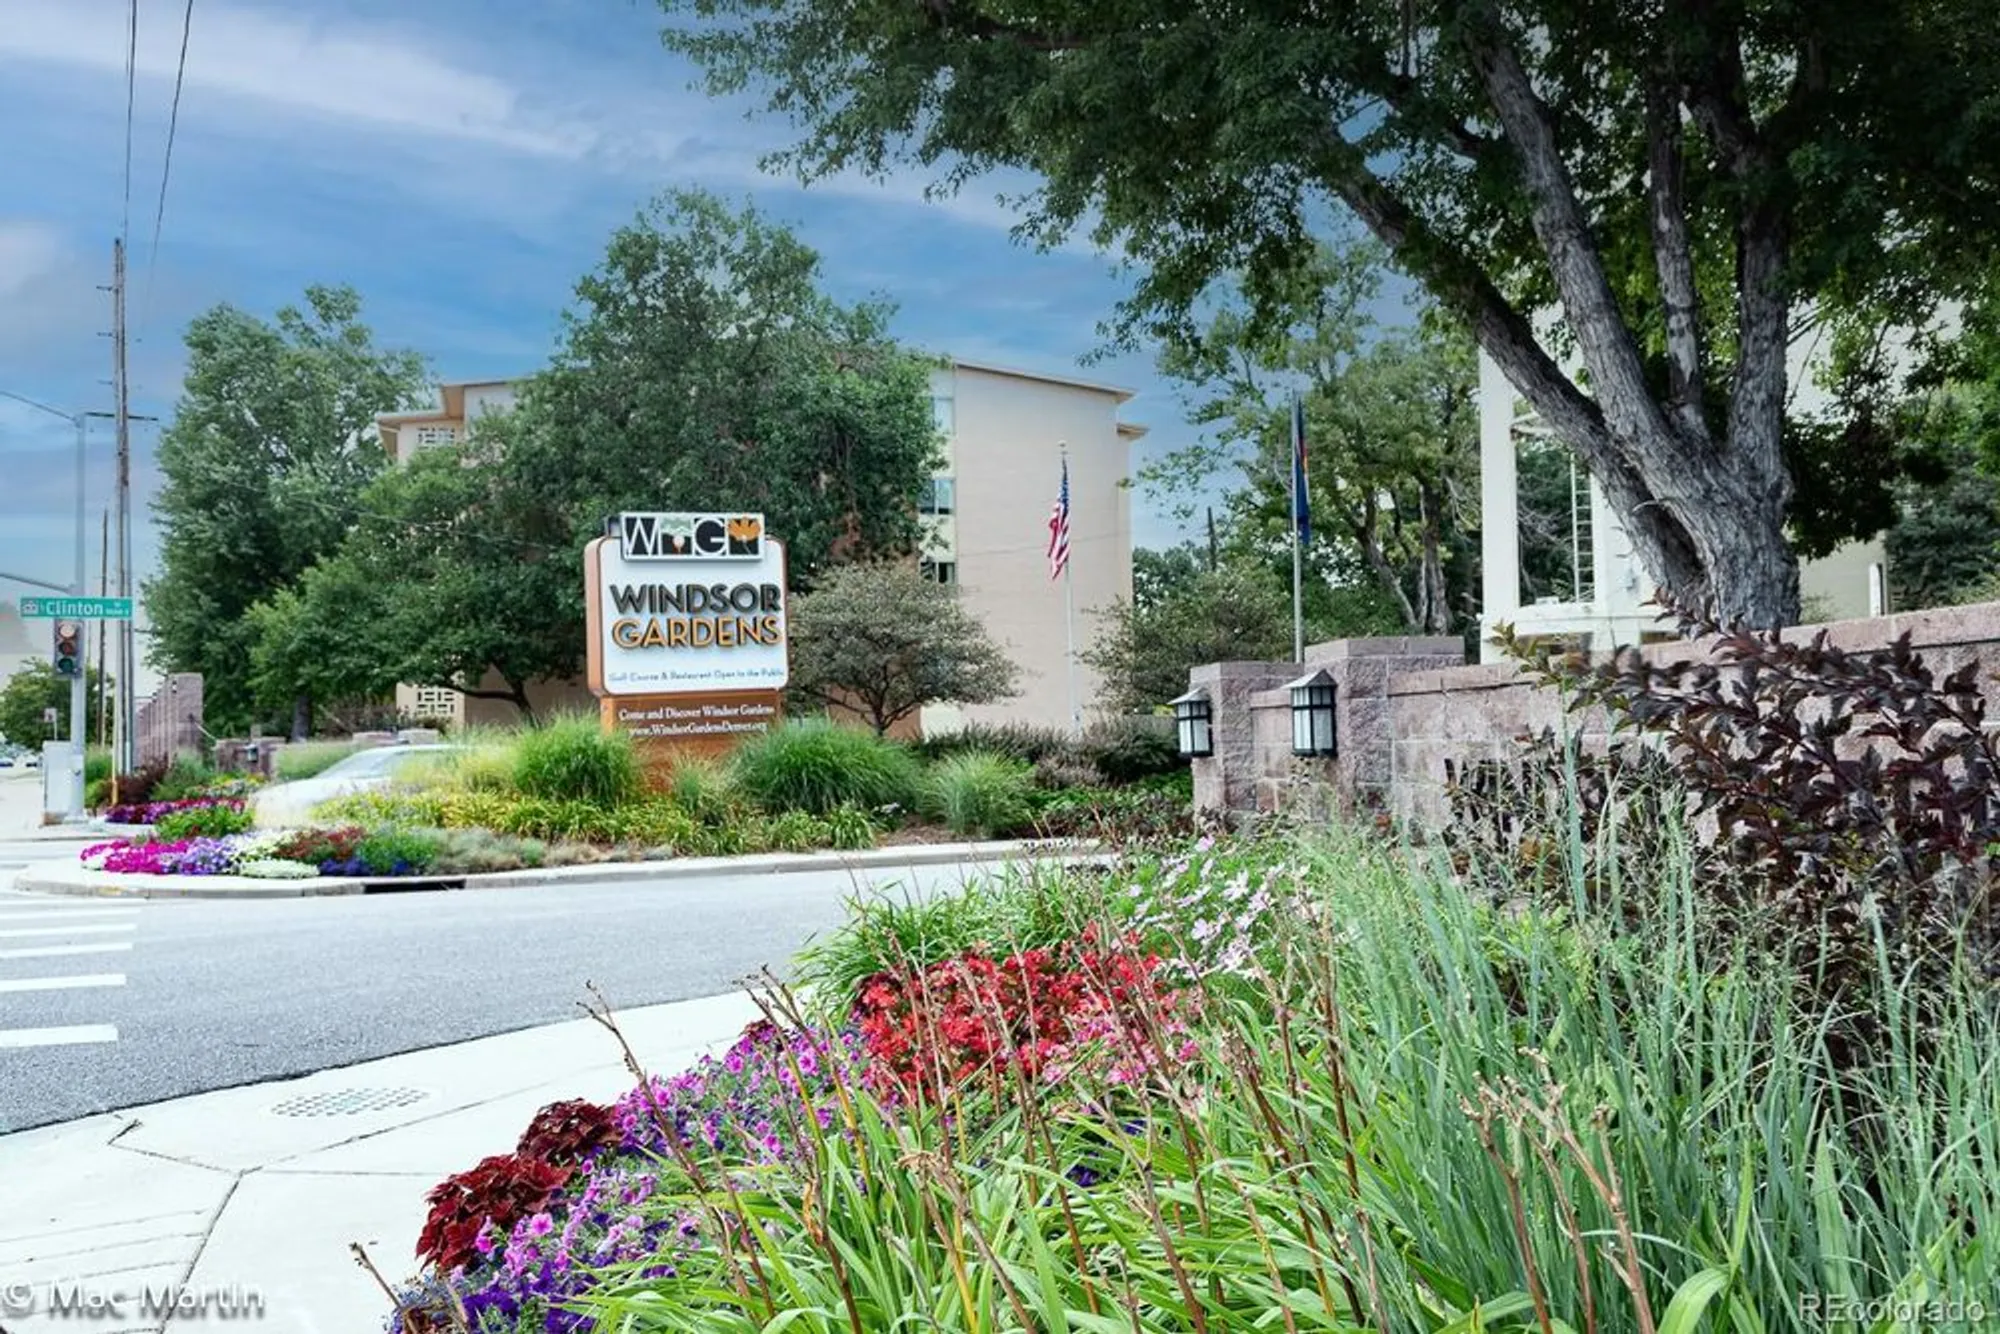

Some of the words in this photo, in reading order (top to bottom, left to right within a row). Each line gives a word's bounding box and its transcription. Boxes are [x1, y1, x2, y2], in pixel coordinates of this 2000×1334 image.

[46, 601, 103, 615] Clinton
[609, 583, 783, 615] WINDSOR
[612, 615, 784, 650] GARDENS
[714, 669, 735, 680] Open
[747, 668, 760, 677] the
[618, 707, 645, 721] Come
[647, 706, 664, 720] and
[665, 706, 701, 719] Discover
[702, 703, 739, 717] Windsor
[740, 703, 776, 716] Gardens
